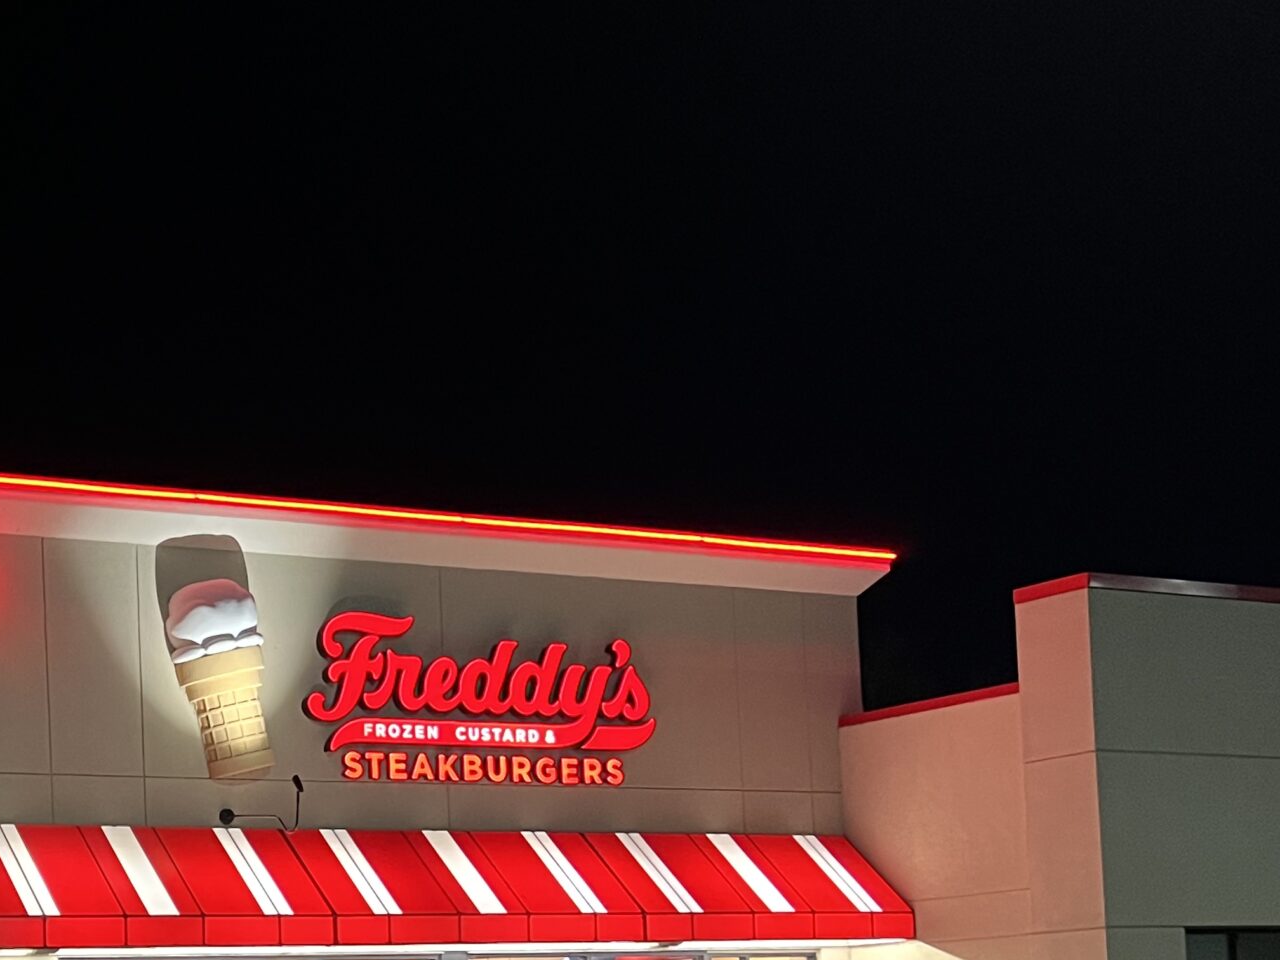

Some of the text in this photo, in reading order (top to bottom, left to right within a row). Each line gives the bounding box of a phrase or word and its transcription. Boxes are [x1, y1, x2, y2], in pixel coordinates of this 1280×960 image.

[305, 610, 656, 750] Freddy's
[363, 723, 556, 744] FROZEN CUSTARD &
[342, 750, 626, 786] STEAKBURGERS
